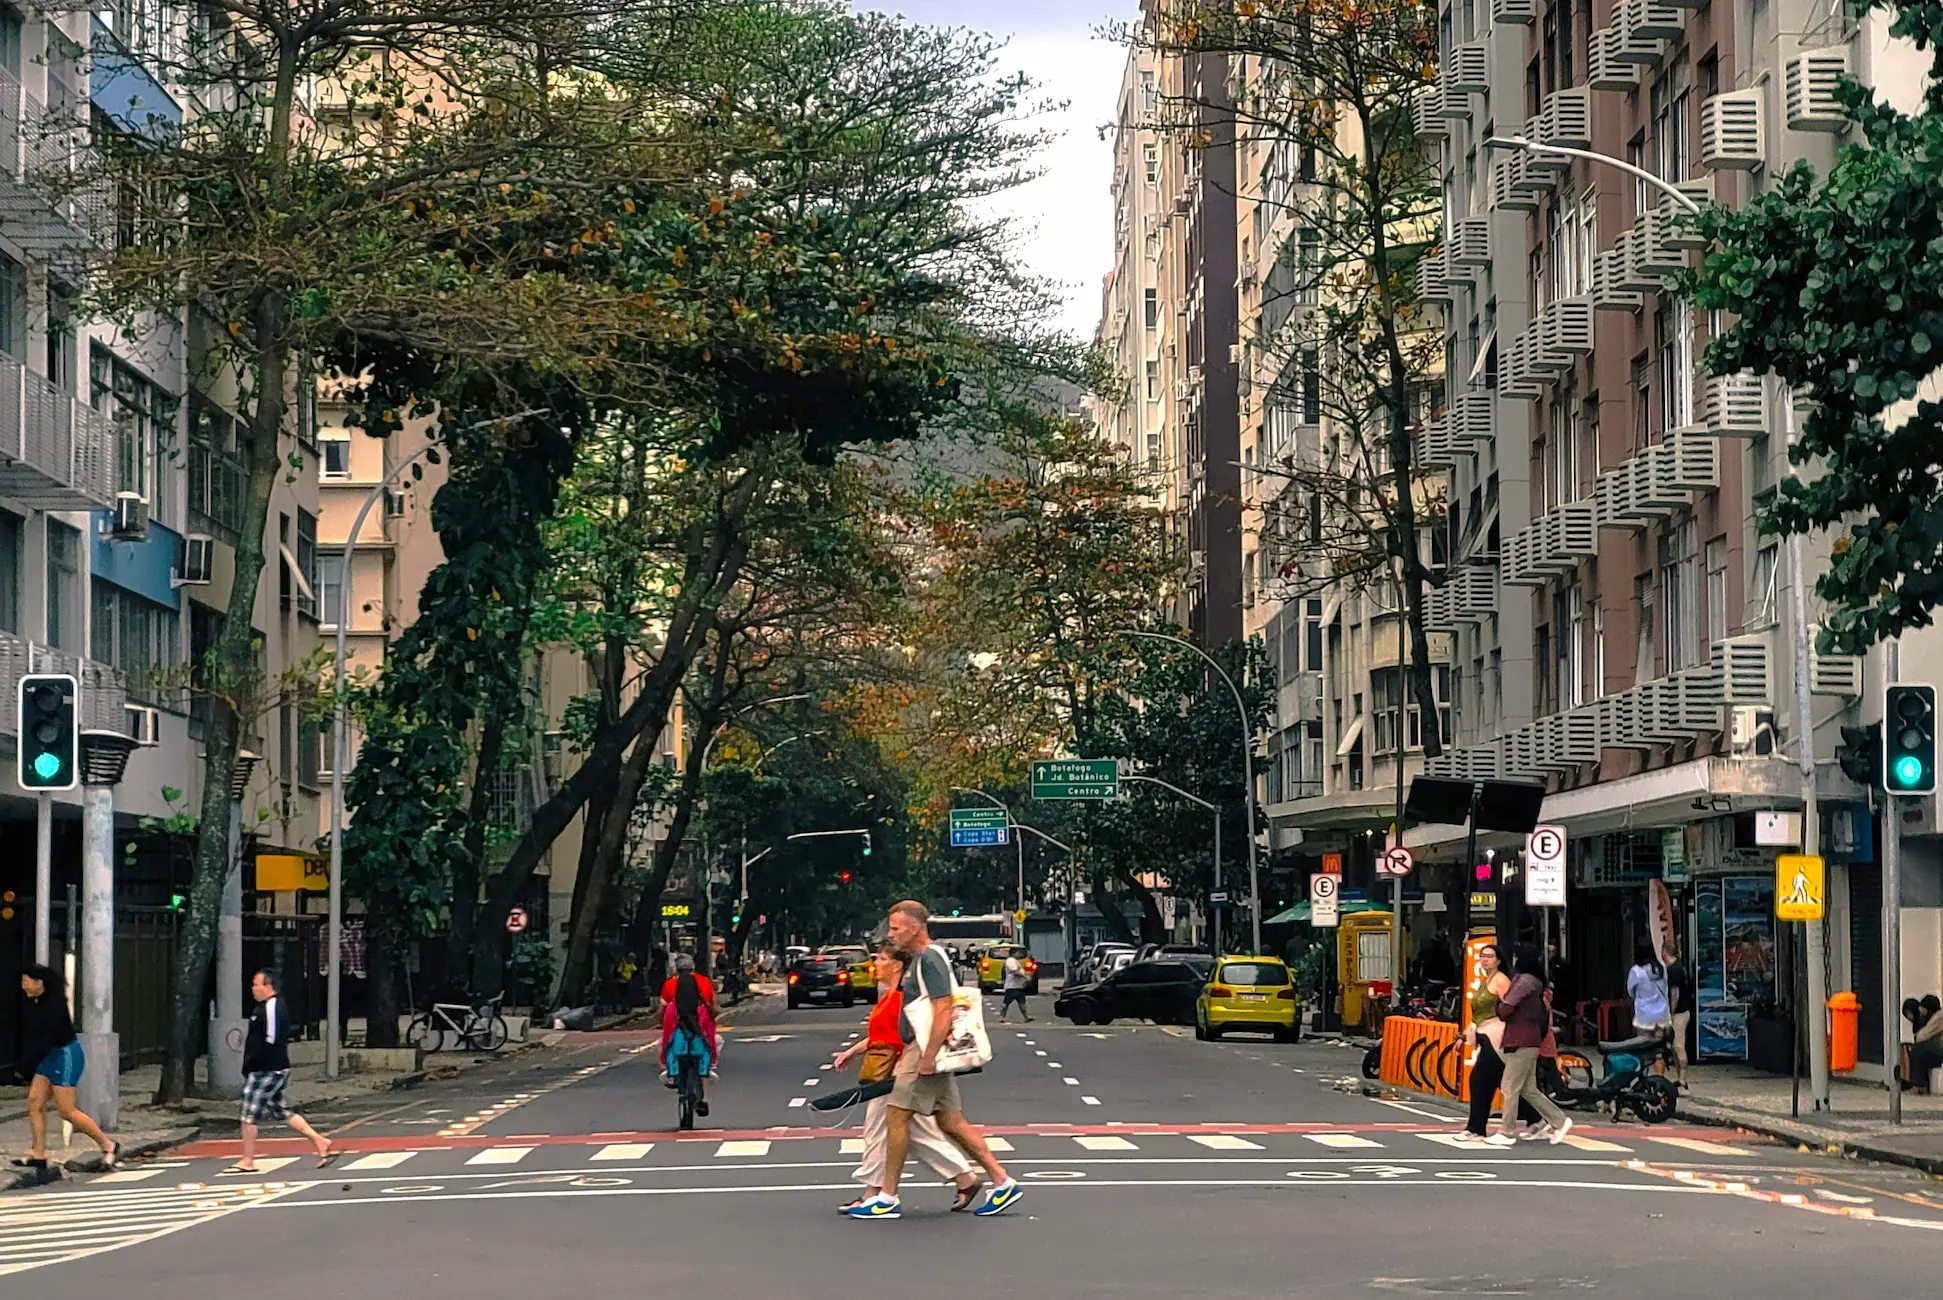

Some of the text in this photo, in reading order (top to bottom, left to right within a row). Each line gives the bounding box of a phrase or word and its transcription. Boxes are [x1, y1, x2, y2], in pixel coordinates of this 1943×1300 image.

[1051, 764, 1091, 773] Botafogo
[1069, 773, 1110, 781] Botânico
[1068, 787, 1099, 795] Centro
[1541, 836, 1552, 854] E
[1320, 881, 1329, 893] E
[662, 905, 689, 916] 16:04
